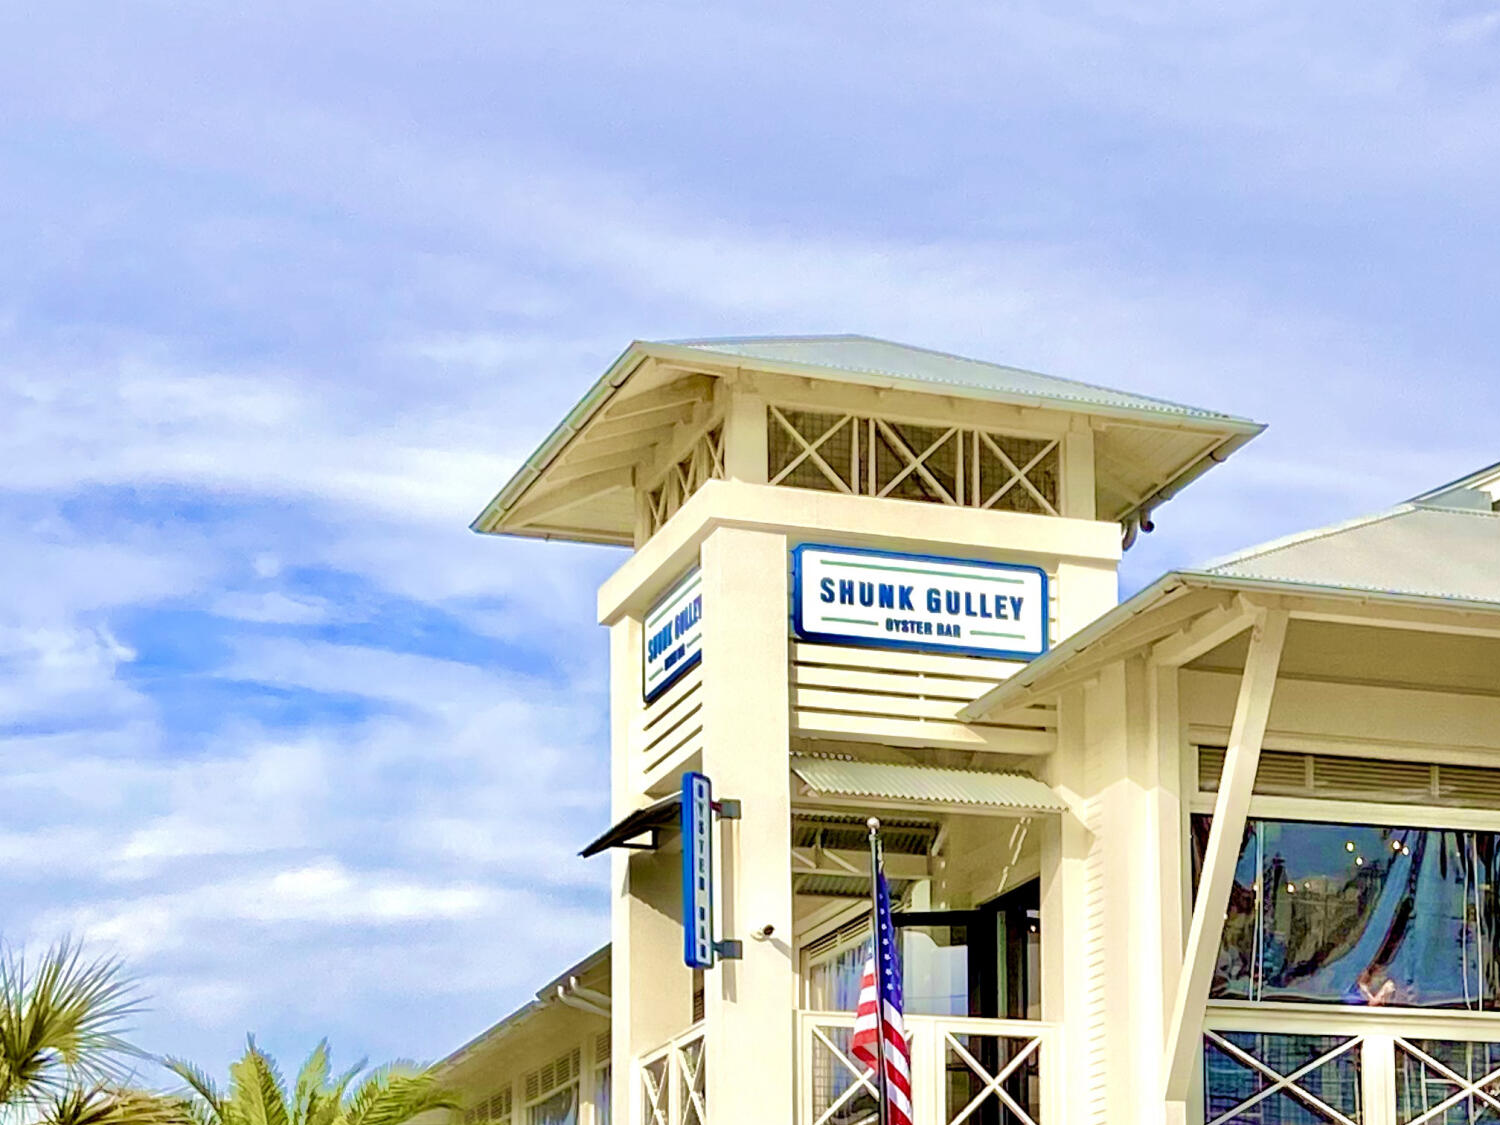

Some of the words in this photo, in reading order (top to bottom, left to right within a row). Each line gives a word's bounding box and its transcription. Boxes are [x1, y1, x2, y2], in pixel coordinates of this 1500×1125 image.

[820, 577, 914, 611] SHUNK
[926, 588, 1024, 621] GULLEY
[885, 617, 932, 635] OYSTER
[936, 623, 961, 638] BAR
